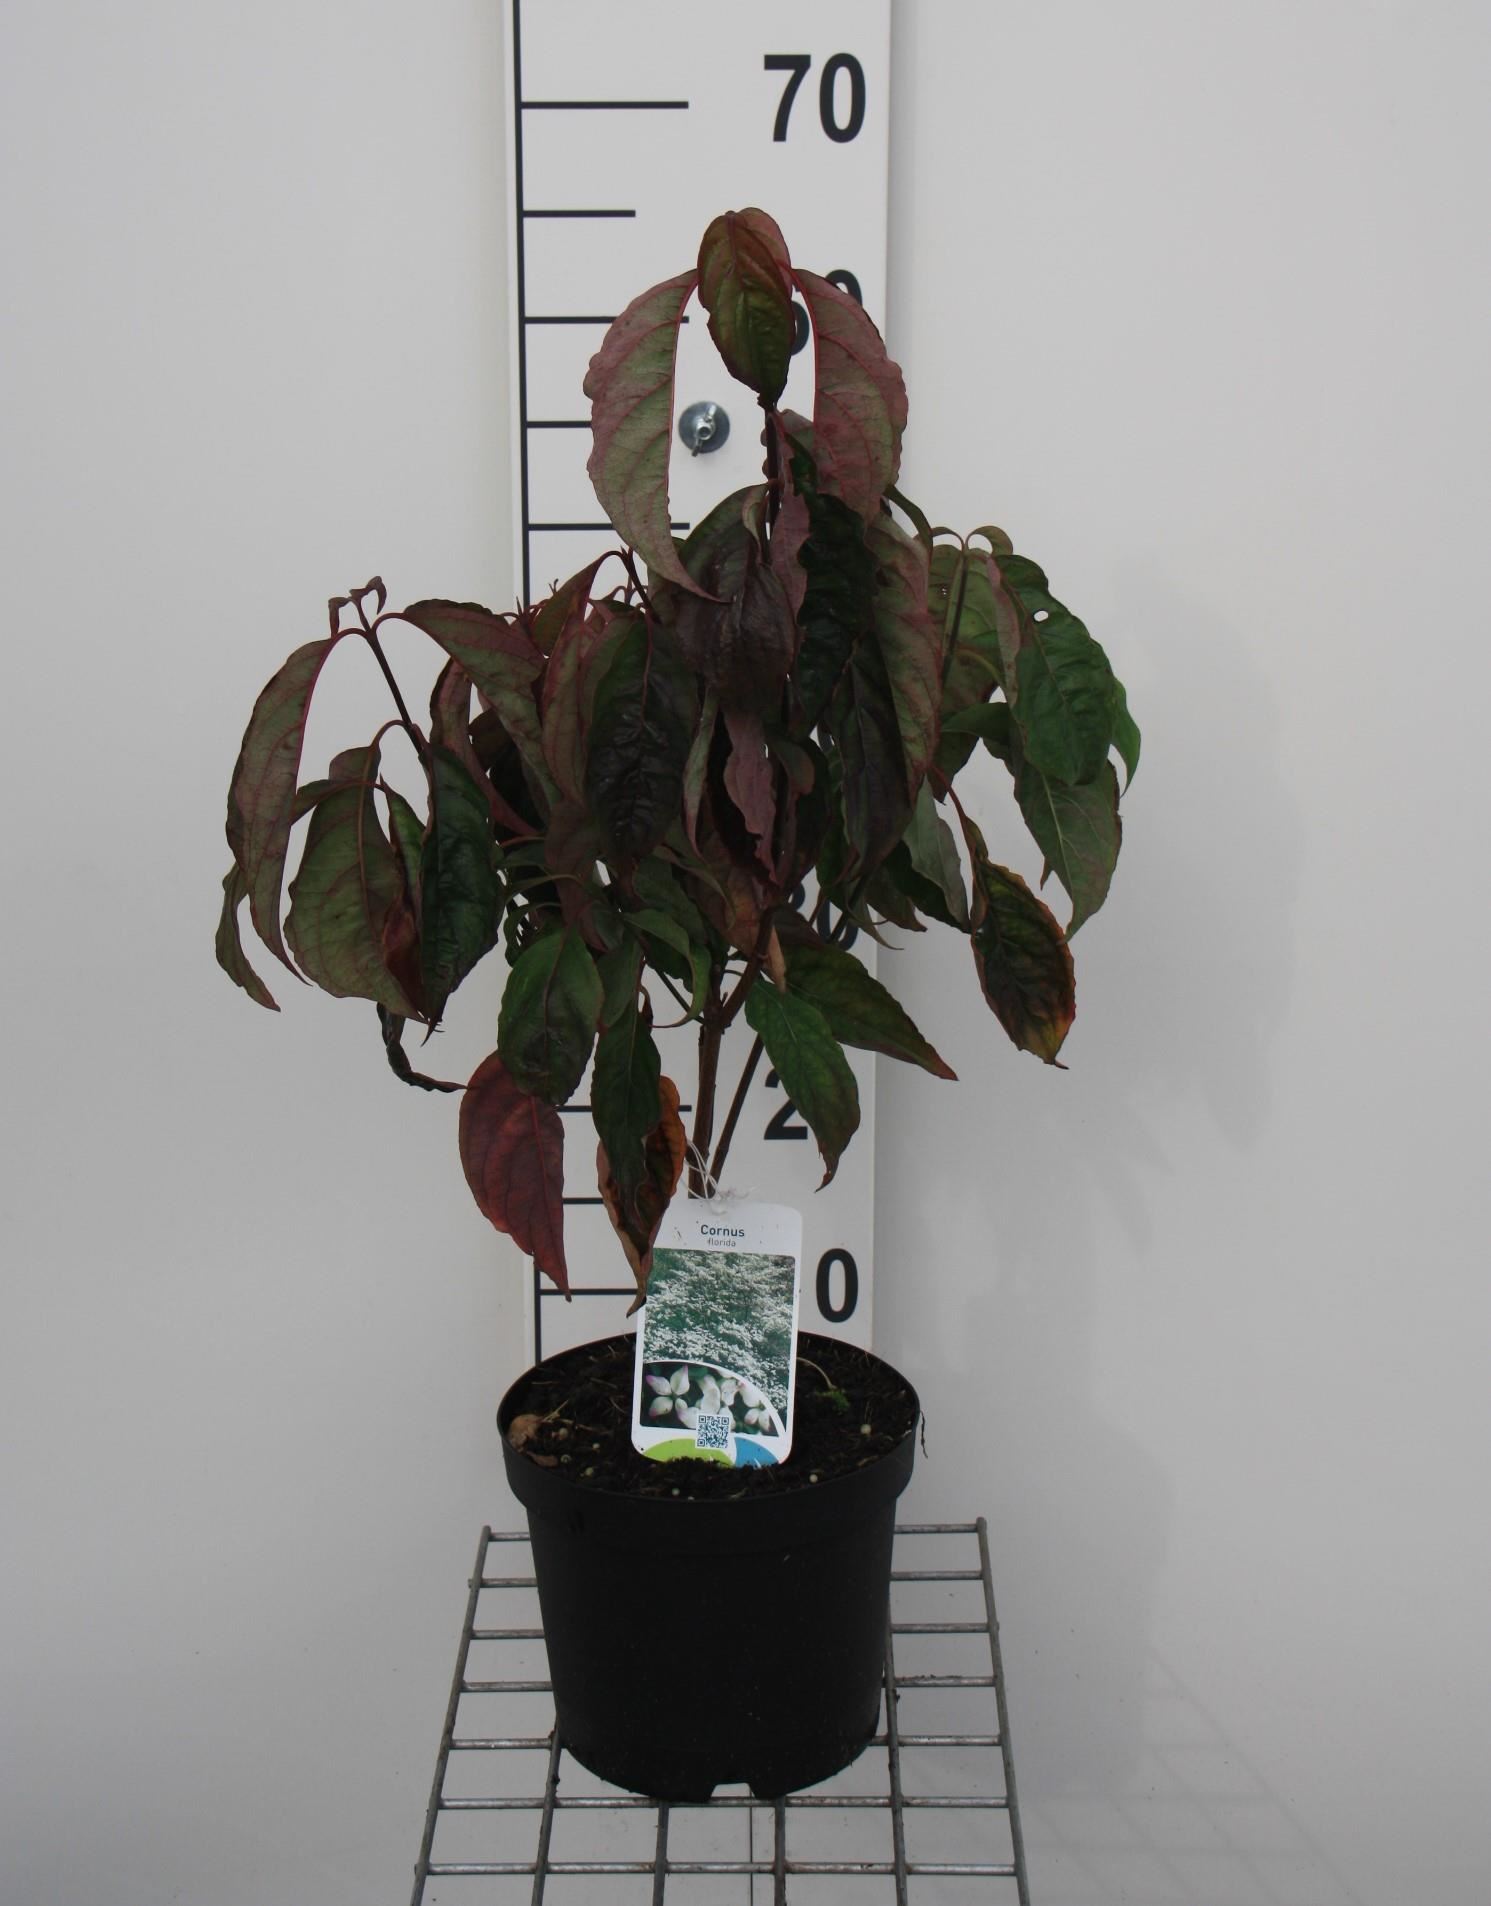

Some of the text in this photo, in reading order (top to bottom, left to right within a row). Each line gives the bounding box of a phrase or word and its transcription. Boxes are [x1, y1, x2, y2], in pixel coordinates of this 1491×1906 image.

[763, 52, 867, 144] 70
[700, 1224, 746, 1238] Cornus
[707, 1239, 737, 1248] florida
[815, 1247, 859, 1324] 0
